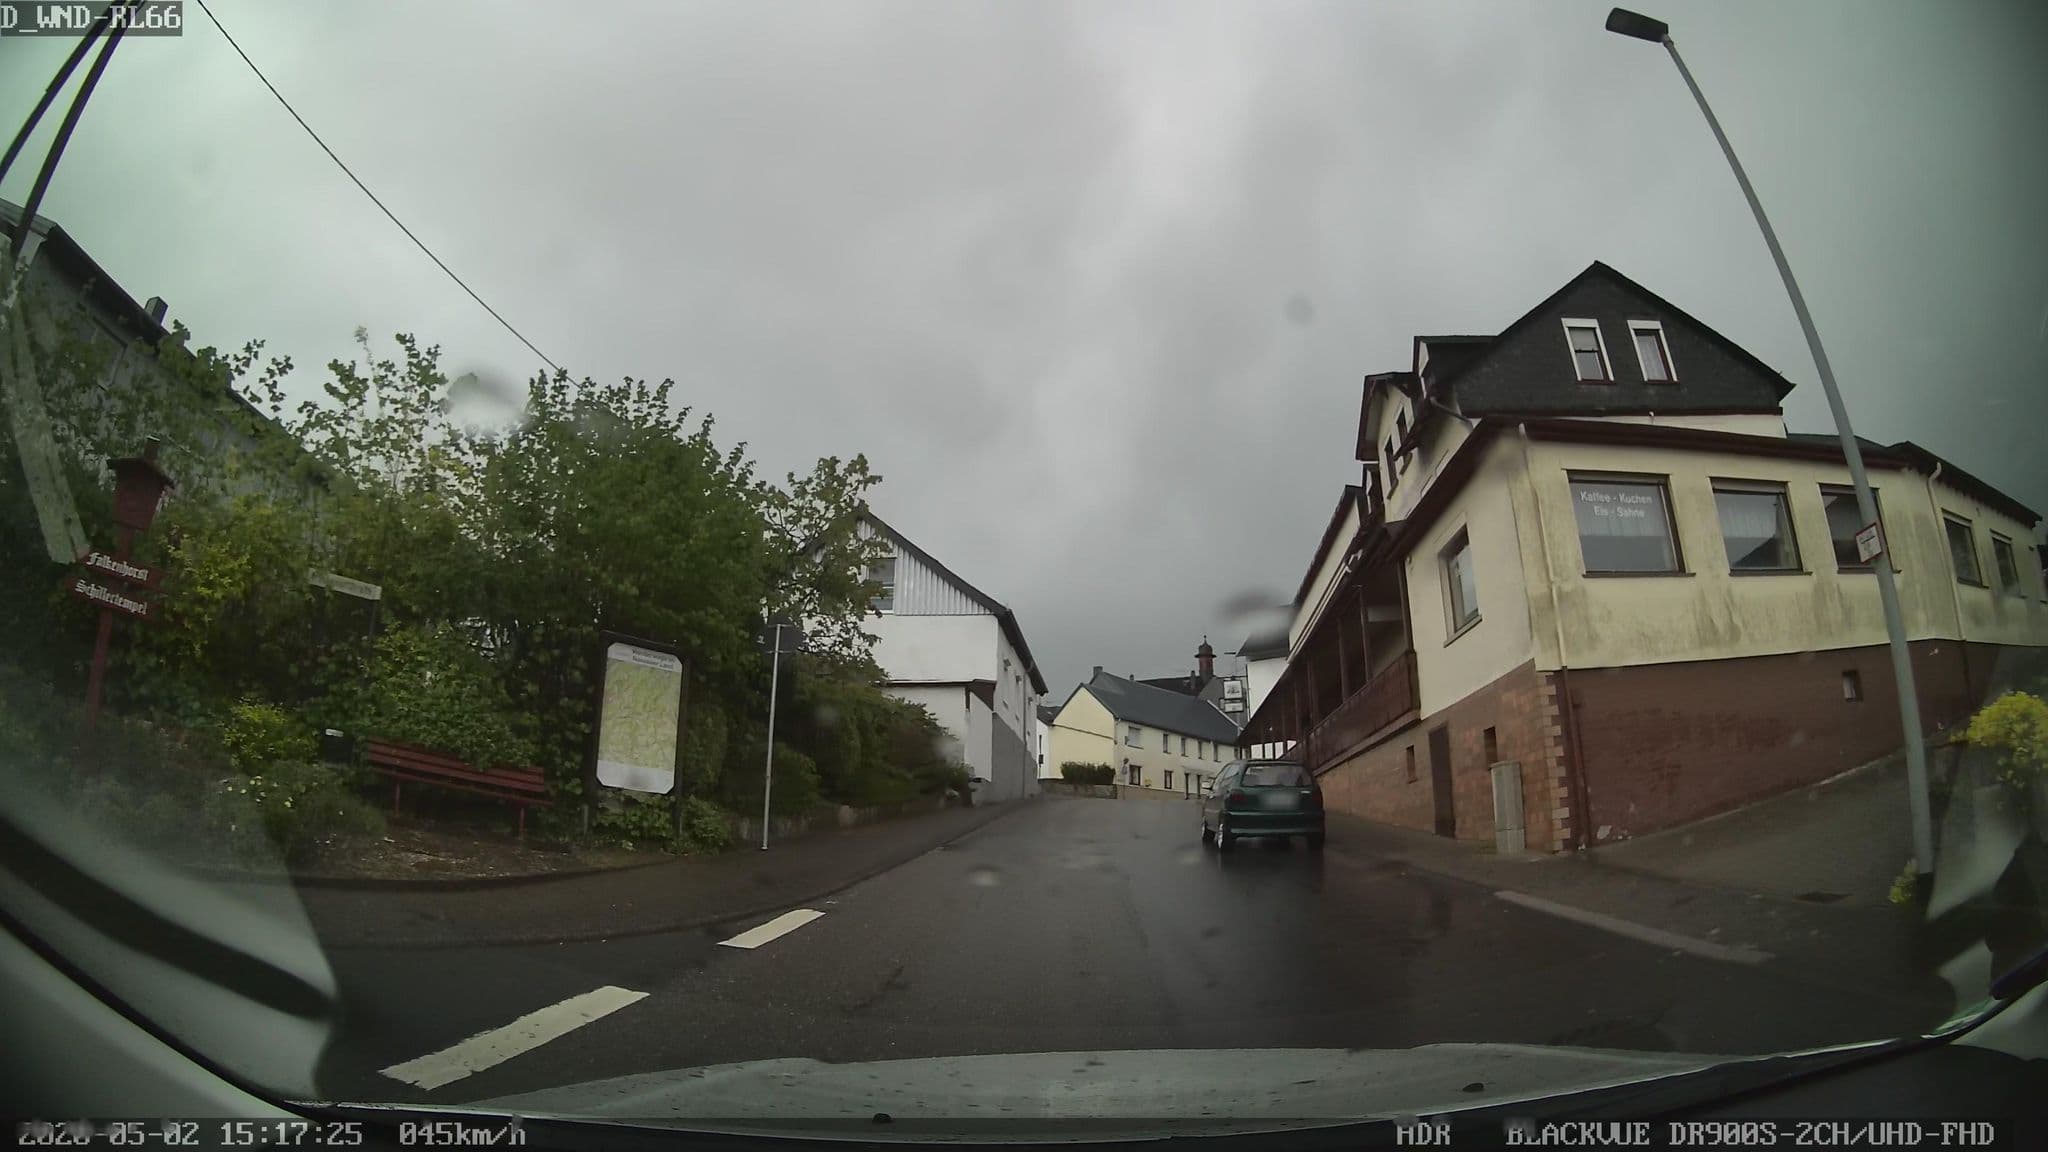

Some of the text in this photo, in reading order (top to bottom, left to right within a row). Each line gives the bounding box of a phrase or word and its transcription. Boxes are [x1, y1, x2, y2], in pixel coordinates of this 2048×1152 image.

[1619, 492, 1652, 504] Kuchen
[1617, 506, 1645, 518] Sahne
[86, 552, 149, 581] Falkenhorst
[75, 579, 147, 615] Schillertempel
